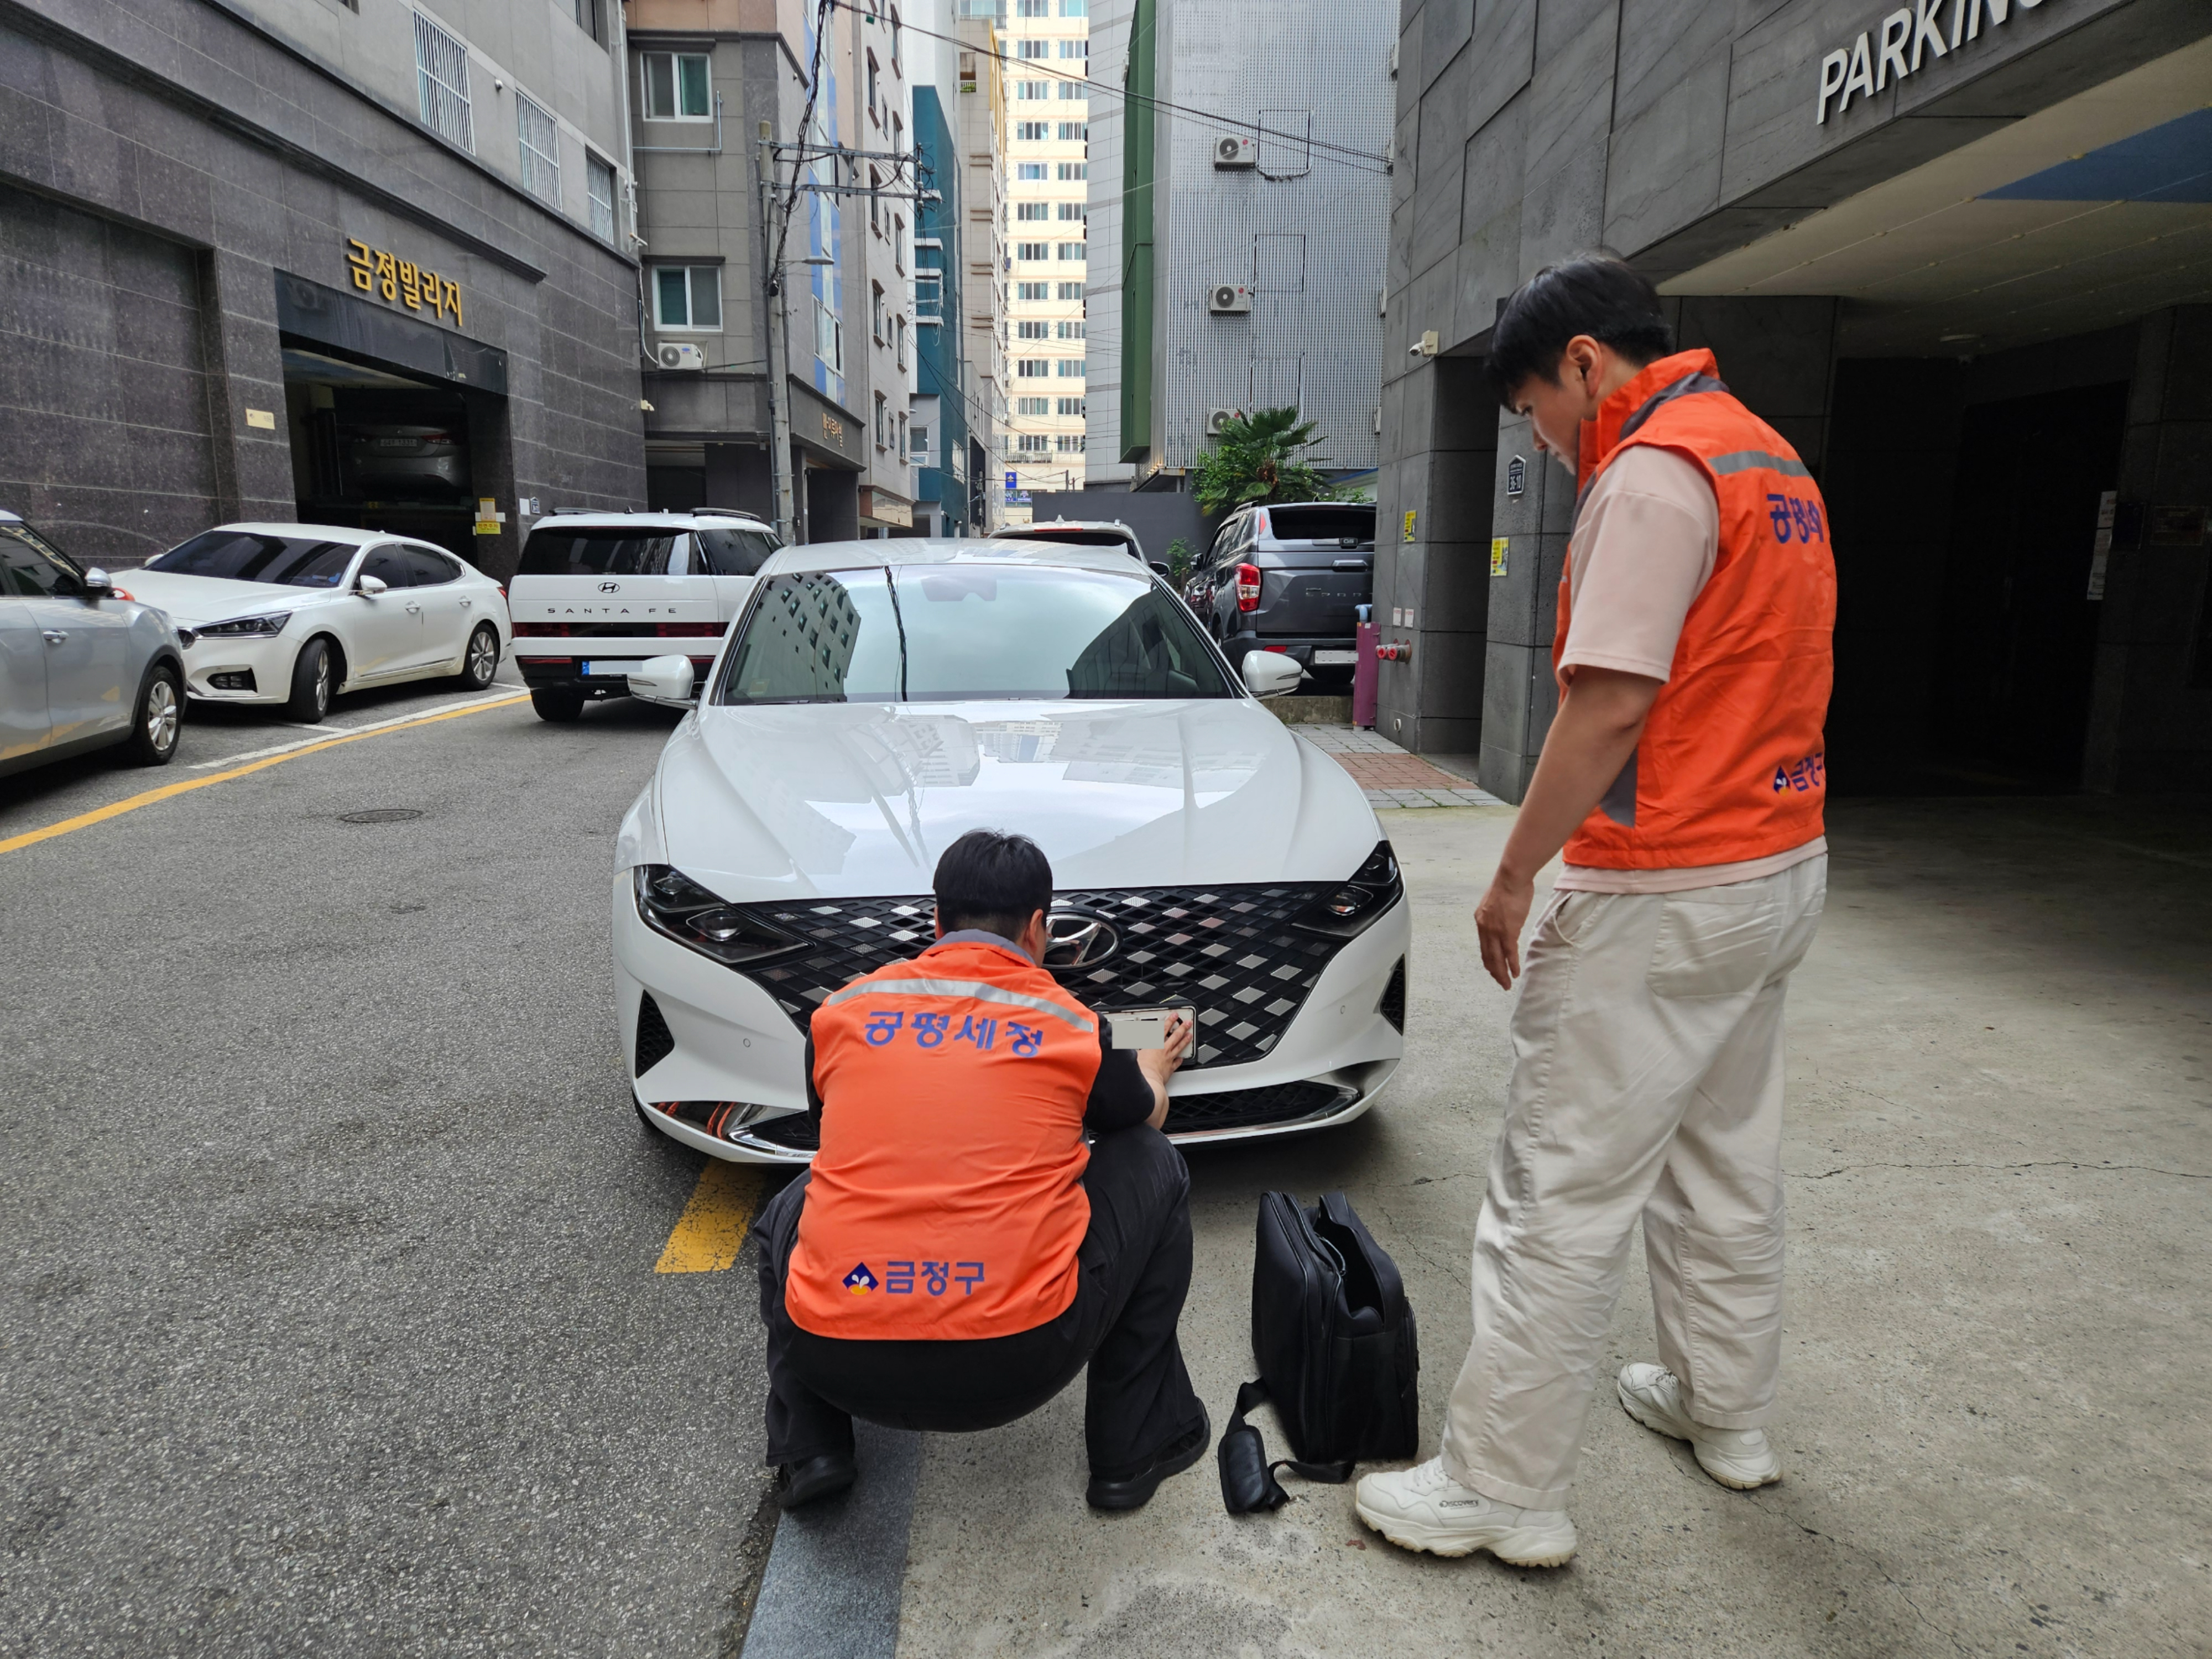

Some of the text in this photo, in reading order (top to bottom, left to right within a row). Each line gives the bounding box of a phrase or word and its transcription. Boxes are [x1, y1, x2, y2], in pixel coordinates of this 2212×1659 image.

[348, 238, 463, 326] 금정빌리지
[864, 1010, 1043, 1058] 공평세정
[885, 1261, 985, 1296] 금정구
